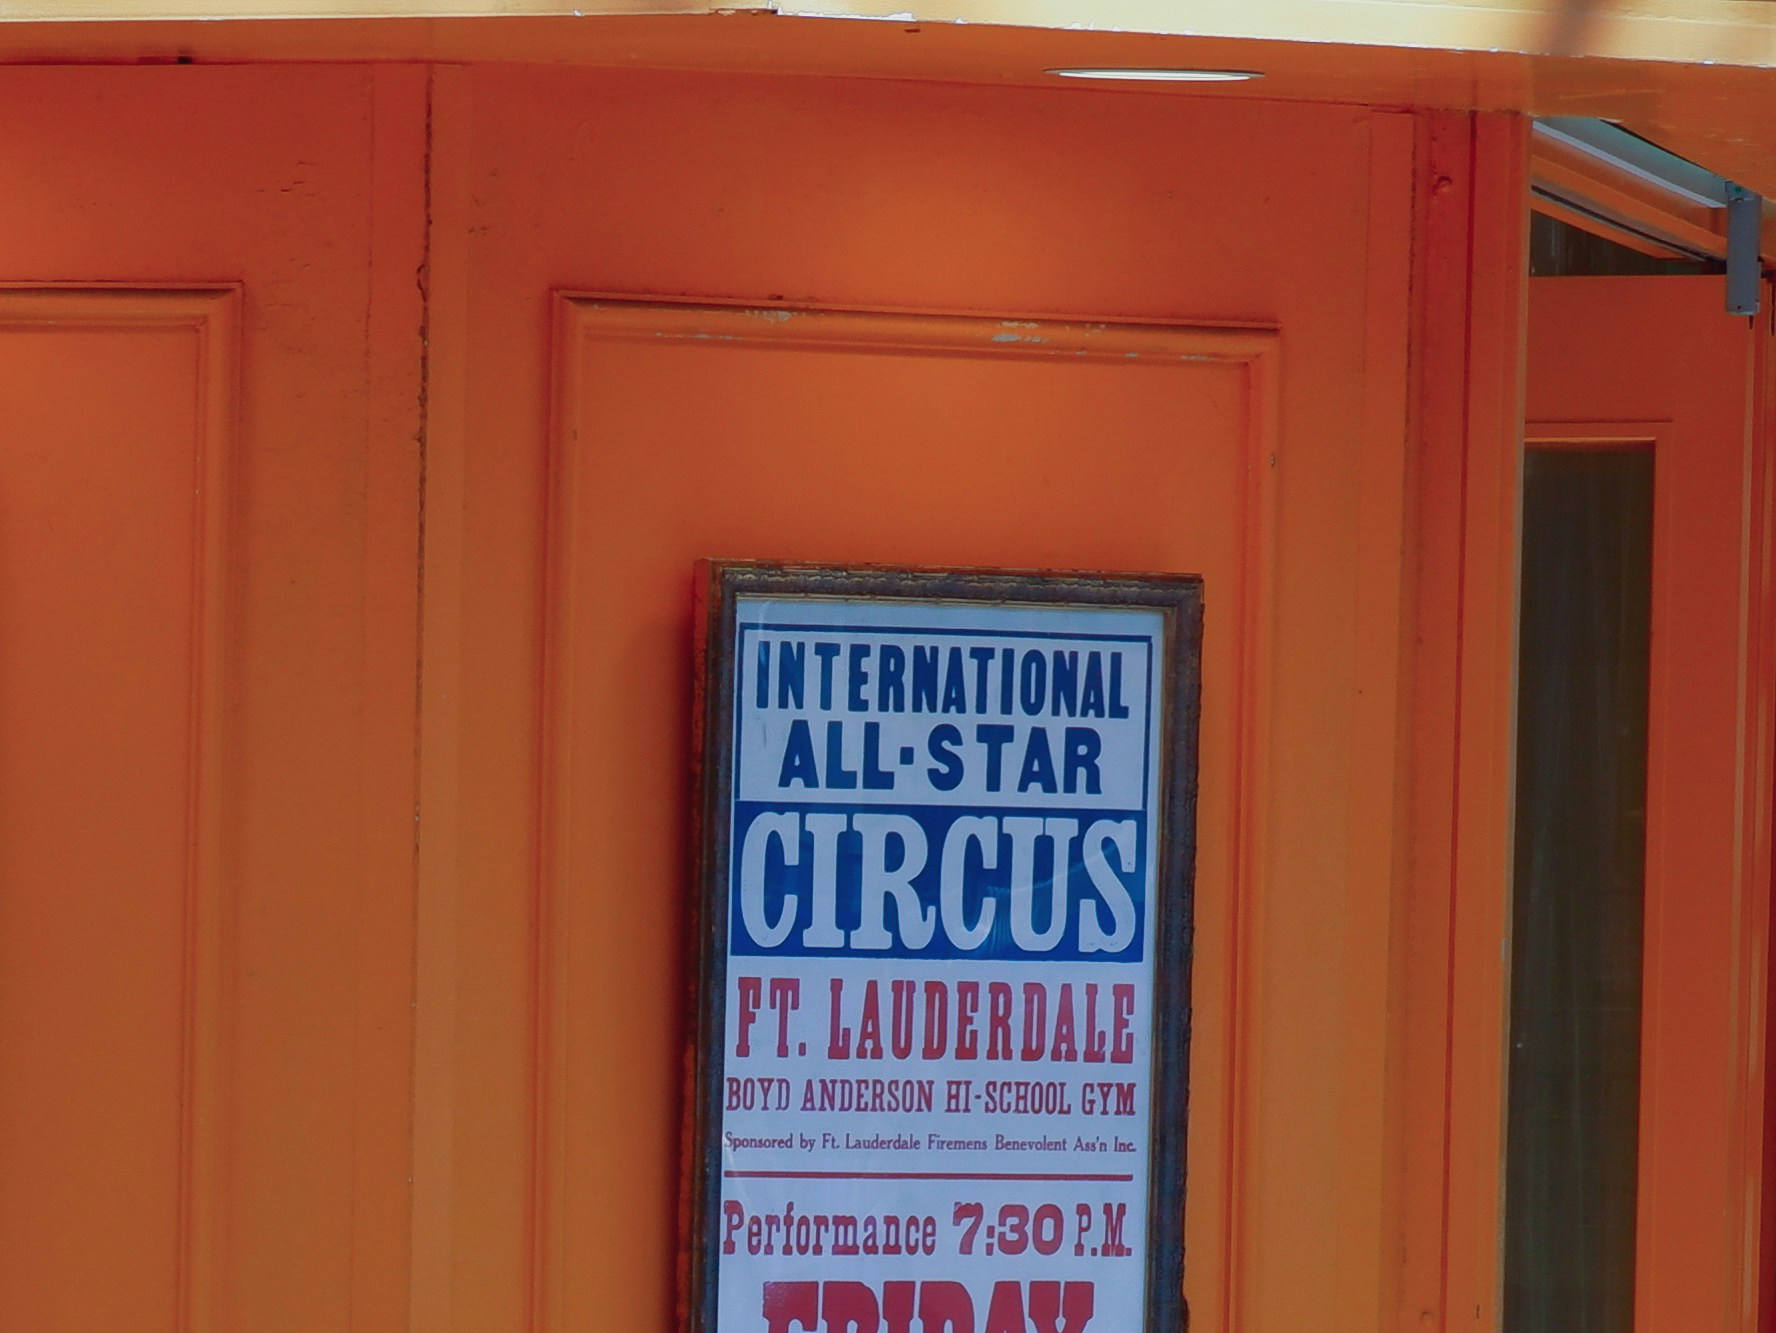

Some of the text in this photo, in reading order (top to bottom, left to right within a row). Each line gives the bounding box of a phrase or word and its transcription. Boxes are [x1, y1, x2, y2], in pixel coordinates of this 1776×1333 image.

[755, 640, 1130, 719] INTERNATIONAL
[740, 811, 1137, 953] CIRCUS
[735, 976, 1136, 1064] FT. LAUDERDALE
[726, 1077, 1137, 1116] BOYD ANDERSON HI-SCHOOL GYM
[724, 1132, 1138, 1155] Sponsored by Ft. Lauderdale Firemens Benevolent Ass'n Inc.
[723, 1200, 1133, 1257] Performance 7:30 P.M.
